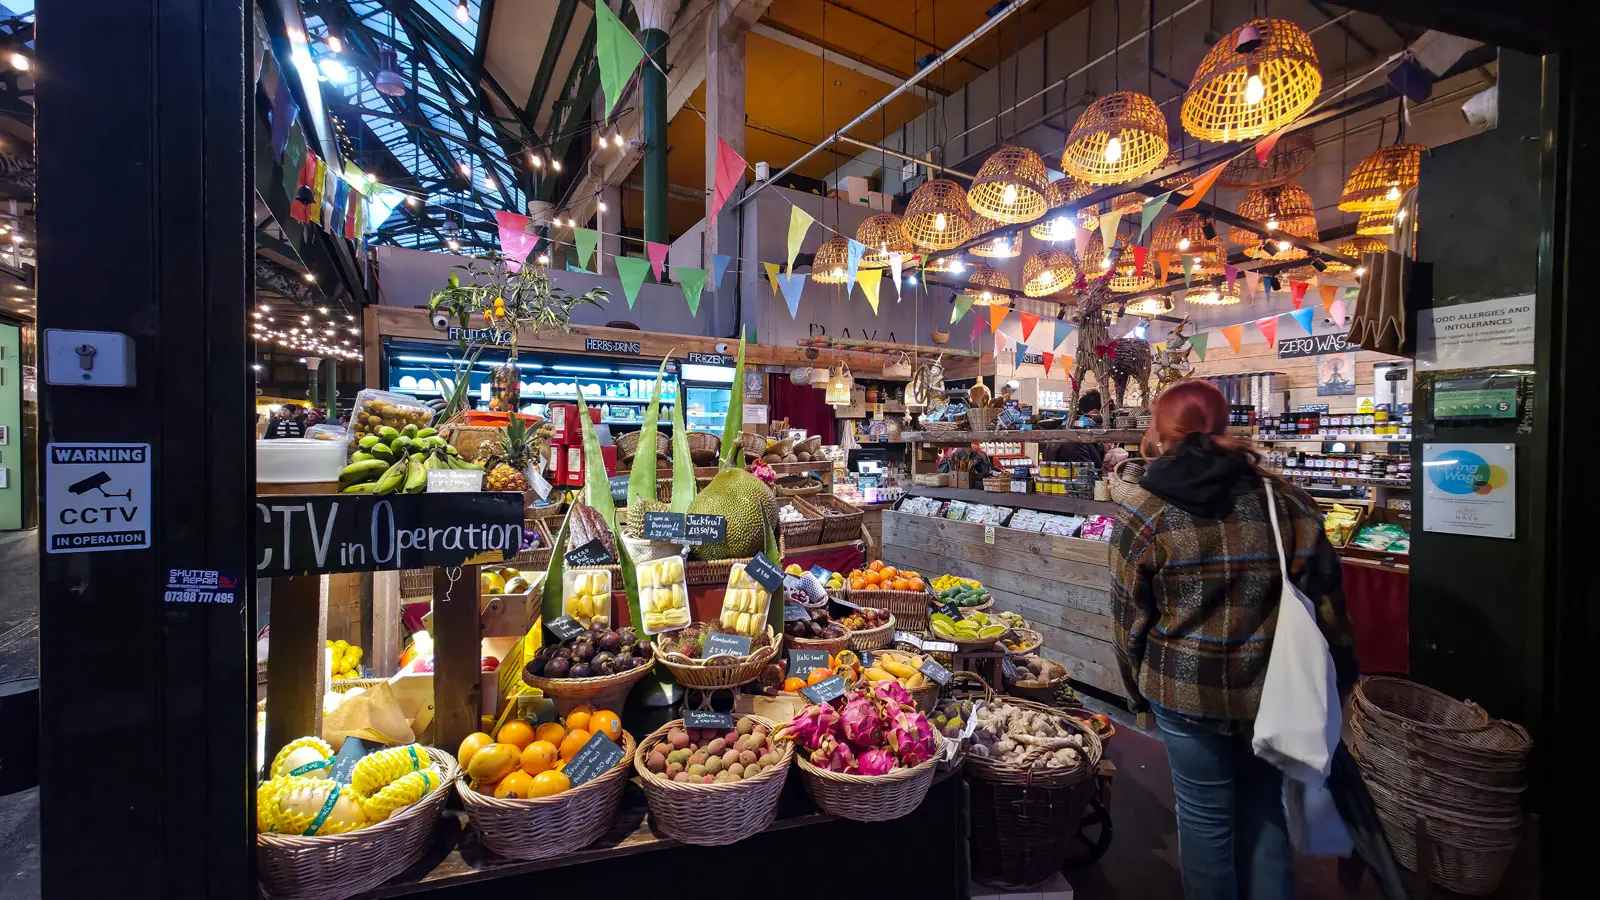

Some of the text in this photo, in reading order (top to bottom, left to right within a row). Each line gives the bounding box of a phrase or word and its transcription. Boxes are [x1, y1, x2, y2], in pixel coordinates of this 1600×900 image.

[1458, 309, 1506, 321] ALLERGIES
[1508, 306, 1530, 315] AND
[1444, 318, 1513, 332] INTOLERANCES
[586, 339, 613, 352] HERBS
[1279, 338, 1313, 355] ZERO
[1314, 333, 1348, 352] WAS
[1499, 402, 1508, 411] 5
[55, 449, 143, 462] WARNING
[1443, 471, 1484, 484] Wage
[59, 506, 138, 525] CCTV
[57, 533, 142, 547] IN OPERATION
[341, 542, 366, 567] in
[371, 500, 523, 568] Operation
[570, 548, 590, 561] Cacao
[169, 569, 219, 578] SHUTTER
[182, 577, 218, 585] REPAIR
[165, 591, 234, 604] 07398 777 495
